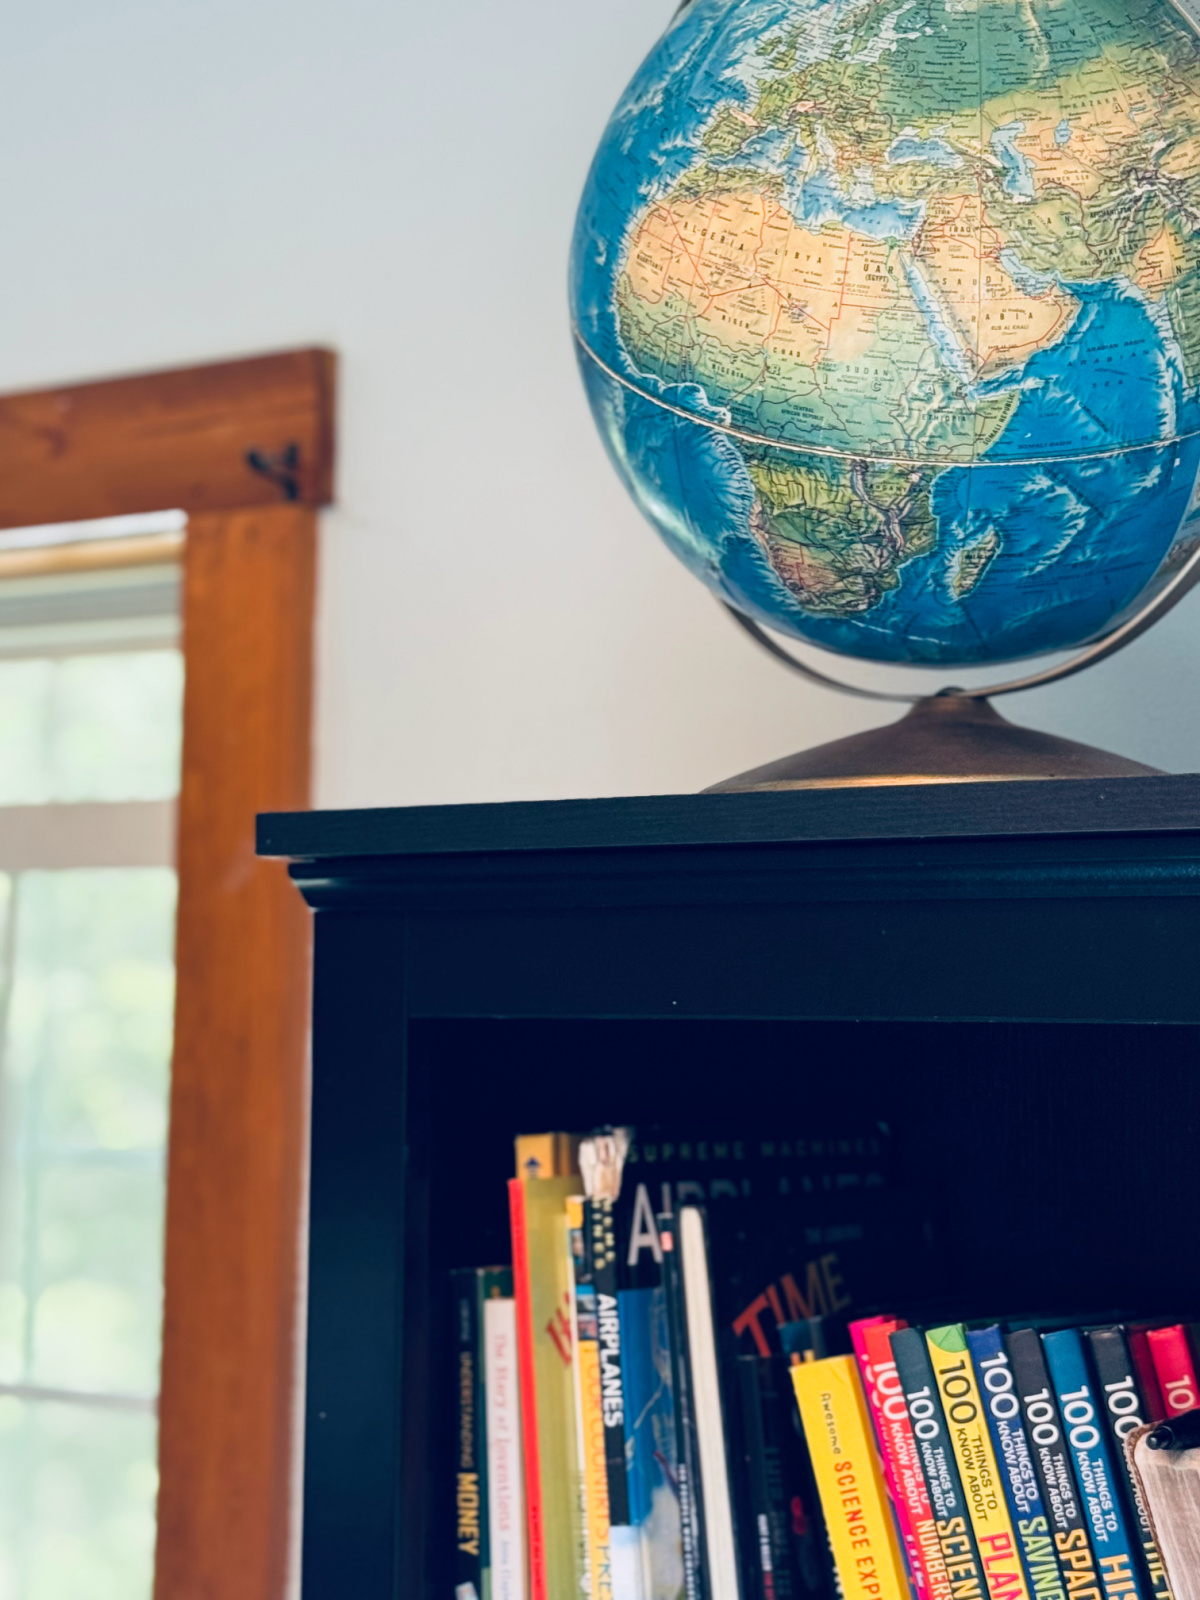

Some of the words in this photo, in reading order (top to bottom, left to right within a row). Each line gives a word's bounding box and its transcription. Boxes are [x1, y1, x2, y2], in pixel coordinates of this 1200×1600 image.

[683, 220, 745, 252] ALGERIA
[774, 248, 822, 265] LIBYA
[949, 226, 971, 234] IRAQ
[863, 262, 894, 275] UAR
[942, 275, 1004, 286] SAUDI
[772, 346, 801, 358] CHAD
[845, 365, 889, 377] SUDAN
[1067, 350, 1149, 367] ARABIAN
[1092, 378, 1123, 389] SEA
[982, 425, 1003, 447] SOMALI
[999, 393, 1016, 425] REPUBLIC
[731, 1251, 852, 1358] TIME
[597, 1292, 624, 1428] AIRPLANES
[873, 1361, 909, 1421] 100
[939, 1358, 977, 1424] 100
[980, 1351, 1019, 1419] 100
[1165, 1374, 1195, 1410] 10
[907, 1386, 939, 1439] 100
[1024, 1387, 1059, 1445] 100
[1060, 1385, 1100, 1449] 100
[1104, 1375, 1144, 1440] 100
[889, 1422, 911, 1465] KNOW
[901, 1469, 924, 1515] ABOUT
[920, 1441, 938, 1477] KNOW
[929, 1478, 949, 1518] ABOUT
[933, 1446, 952, 1490] THINGS
[944, 1490, 957, 1508] TO
[956, 1428, 976, 1471] KNOW
[966, 1474, 988, 1521] ABOUT
[971, 1434, 993, 1488] THINGS
[985, 1490, 998, 1510] TO
[996, 1420, 1018, 1464] KNOW
[1007, 1466, 1031, 1514] ABOUT
[1011, 1428, 1034, 1480] THINGS
[1024, 1479, 1039, 1501] TO
[1038, 1447, 1058, 1486] KNOW
[1048, 1487, 1069, 1529] ABOUT
[1052, 1453, 1074, 1500] THINGS
[1064, 1500, 1077, 1519] TO
[1076, 1451, 1097, 1494] KNOW
[1087, 1496, 1109, 1542] ABOUT
[1092, 1457, 1114, 1511] THINGS
[1104, 1511, 1119, 1533] TO
[457, 1472, 480, 1556] MONEY
[834, 1461, 870, 1551] SCIENCE
[856, 1556, 884, 1600] EXP
[596, 1545, 613, 1600] PRE
[936, 1516, 984, 1600] SCIEN
